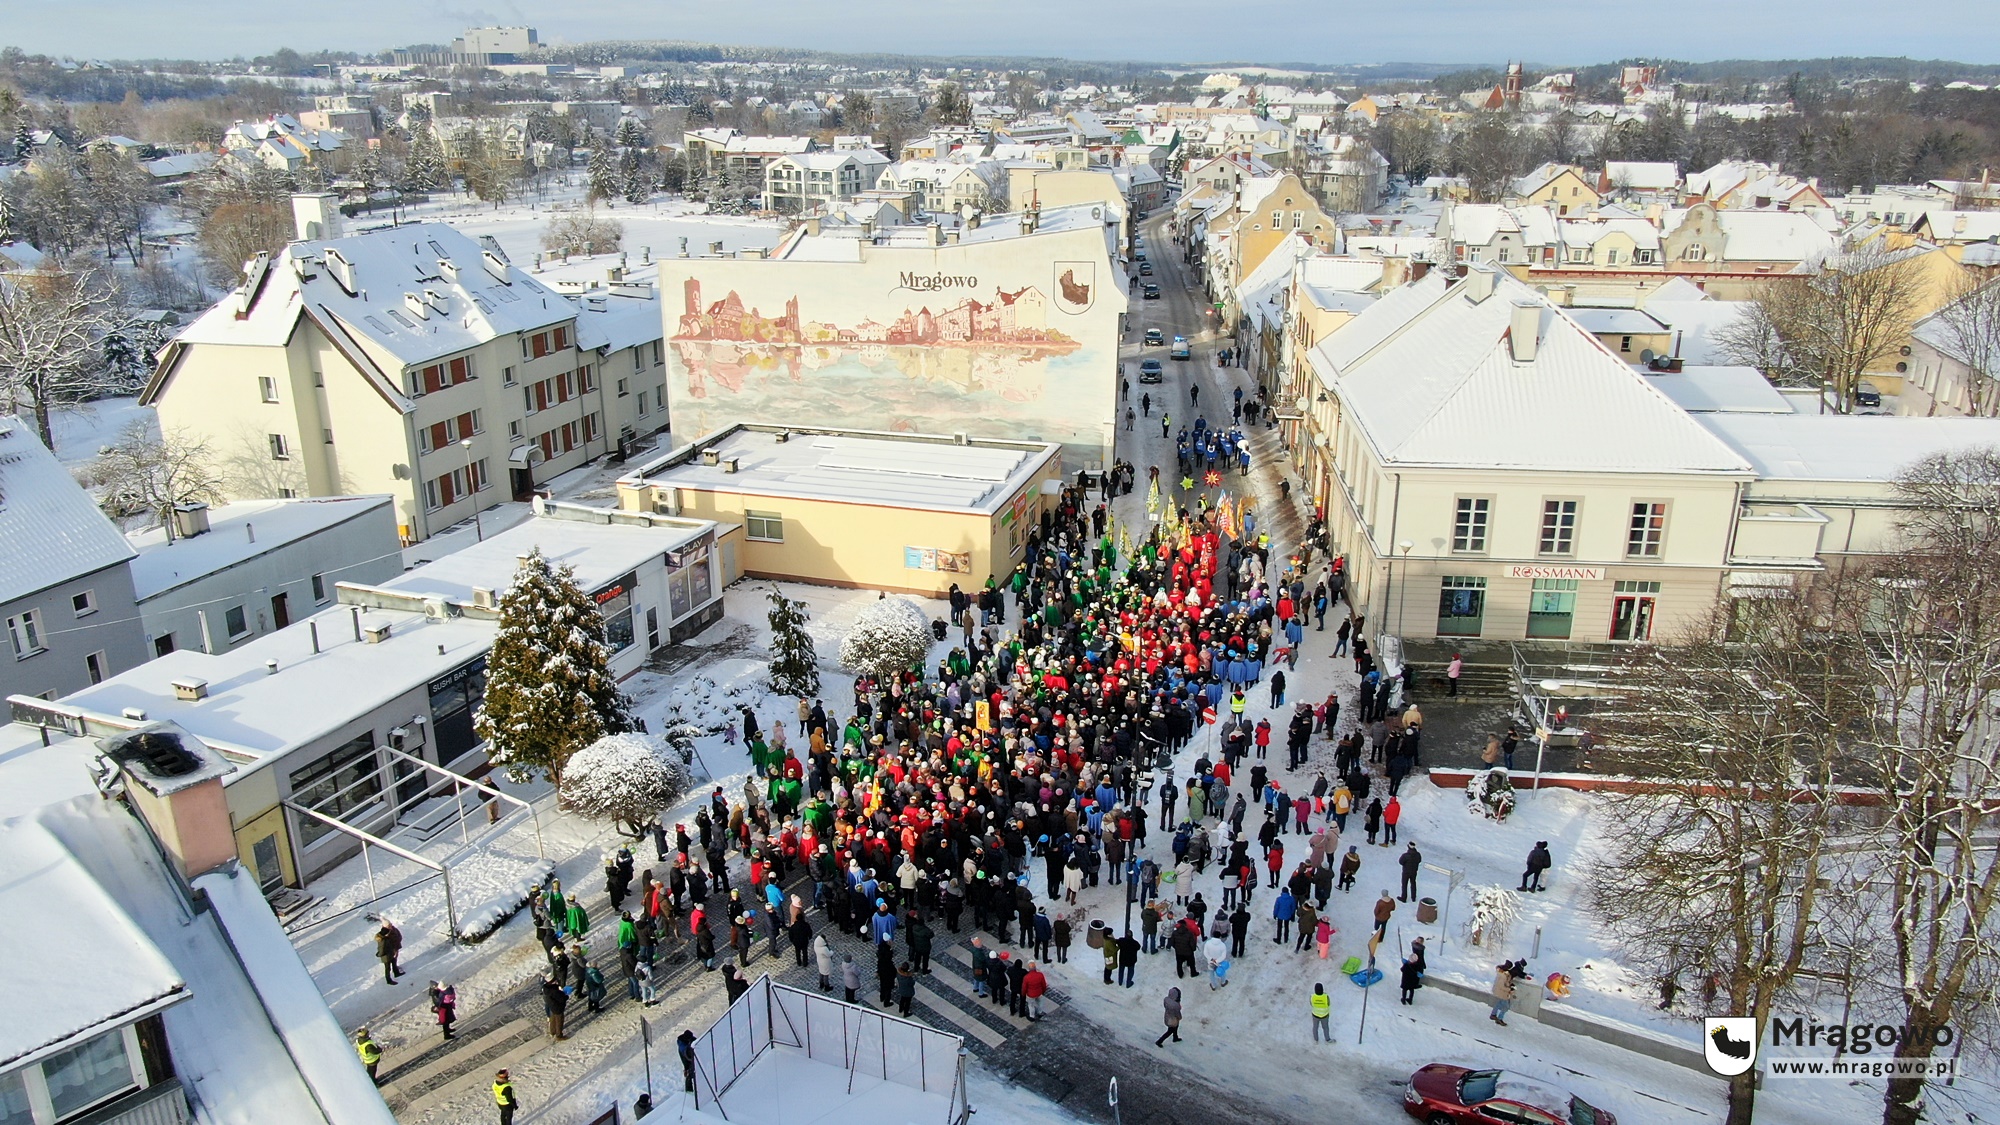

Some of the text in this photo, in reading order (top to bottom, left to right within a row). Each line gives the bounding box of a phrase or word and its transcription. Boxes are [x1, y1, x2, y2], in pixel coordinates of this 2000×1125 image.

[682, 538, 703, 555] PLAY
[1512, 566, 1597, 579] ROSSMANN
[596, 585, 623, 604] Orange
[432, 669, 468, 693] SUSHI BAR
